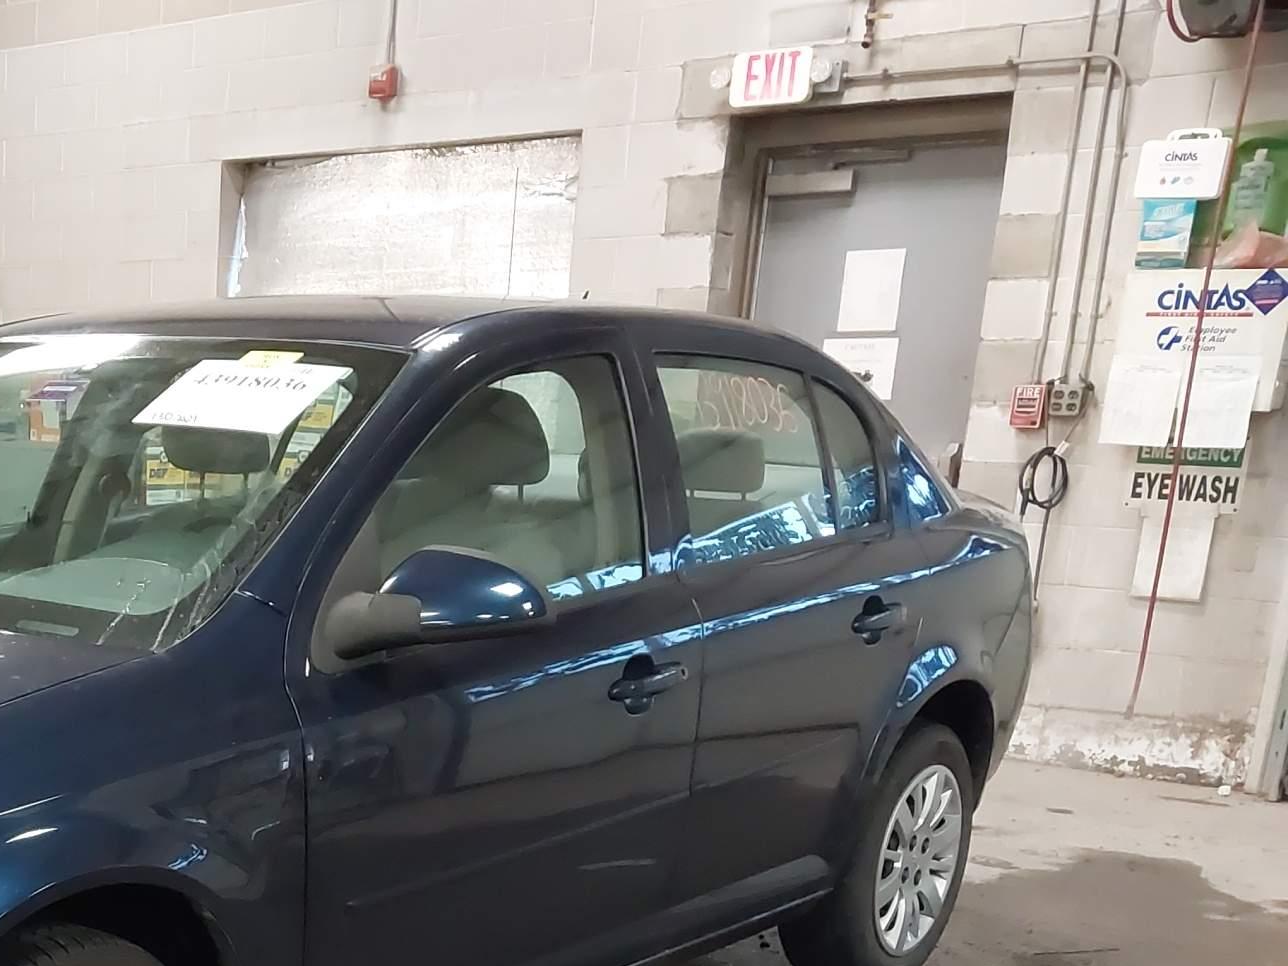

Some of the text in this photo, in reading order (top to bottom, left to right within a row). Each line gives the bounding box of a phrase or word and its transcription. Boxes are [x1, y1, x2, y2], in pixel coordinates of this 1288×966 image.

[743, 50, 802, 101] EXIT
[1189, 326, 1237, 335] Eployee
[1016, 387, 1041, 397] FIRE
[1140, 446, 1242, 463] EMEGENCY
[1131, 472, 1240, 505] EYE WASH
